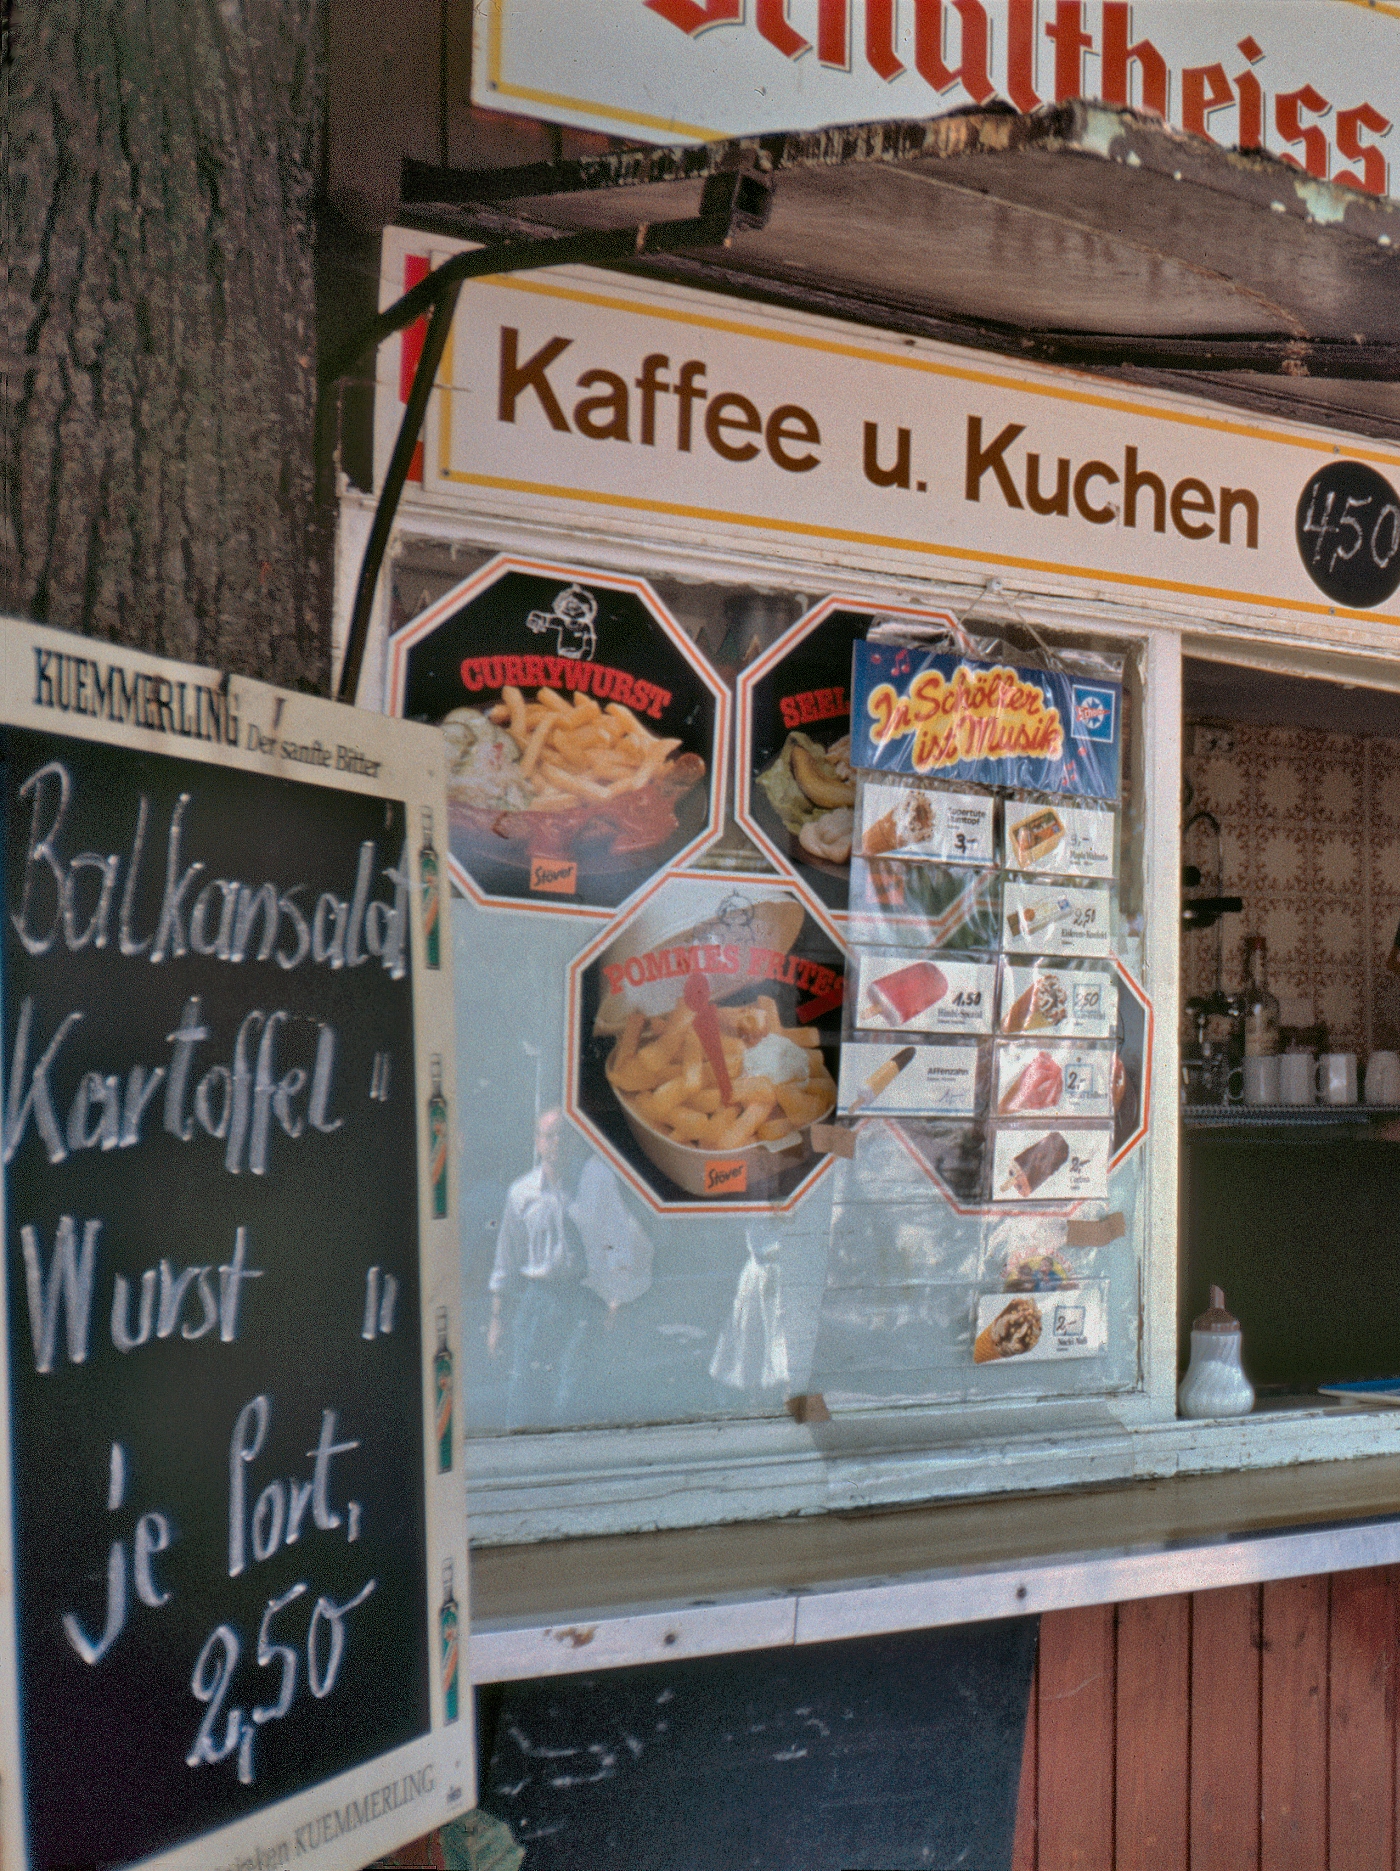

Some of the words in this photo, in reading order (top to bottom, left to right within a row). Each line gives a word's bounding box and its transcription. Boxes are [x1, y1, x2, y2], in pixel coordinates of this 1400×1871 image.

[642, 0, 1392, 196] ultheiss
[498, 325, 822, 473] Kaffee
[863, 421, 928, 493] u.
[965, 414, 1260, 550] Kuchen
[33, 645, 241, 747] KUEMMERLING
[460, 654, 673, 719] CURRYWURST
[780, 686, 851, 729] SEEL
[914, 672, 1041, 722] Schöller
[248, 724, 277, 756] Der
[281, 739, 333, 768] sanfte
[335, 744, 381, 778] Bitter
[916, 726, 958, 765] ist
[956, 710, 1061, 753] Musik
[602, 944, 741, 996] POMMES
[1, 996, 343, 1175] Kartoffel
[20, 1214, 264, 1374] Wurst
[62, 1442, 171, 1665] je
[186, 1578, 377, 1785] 2,50
[294, 1763, 435, 1855] KUEMMERLING
